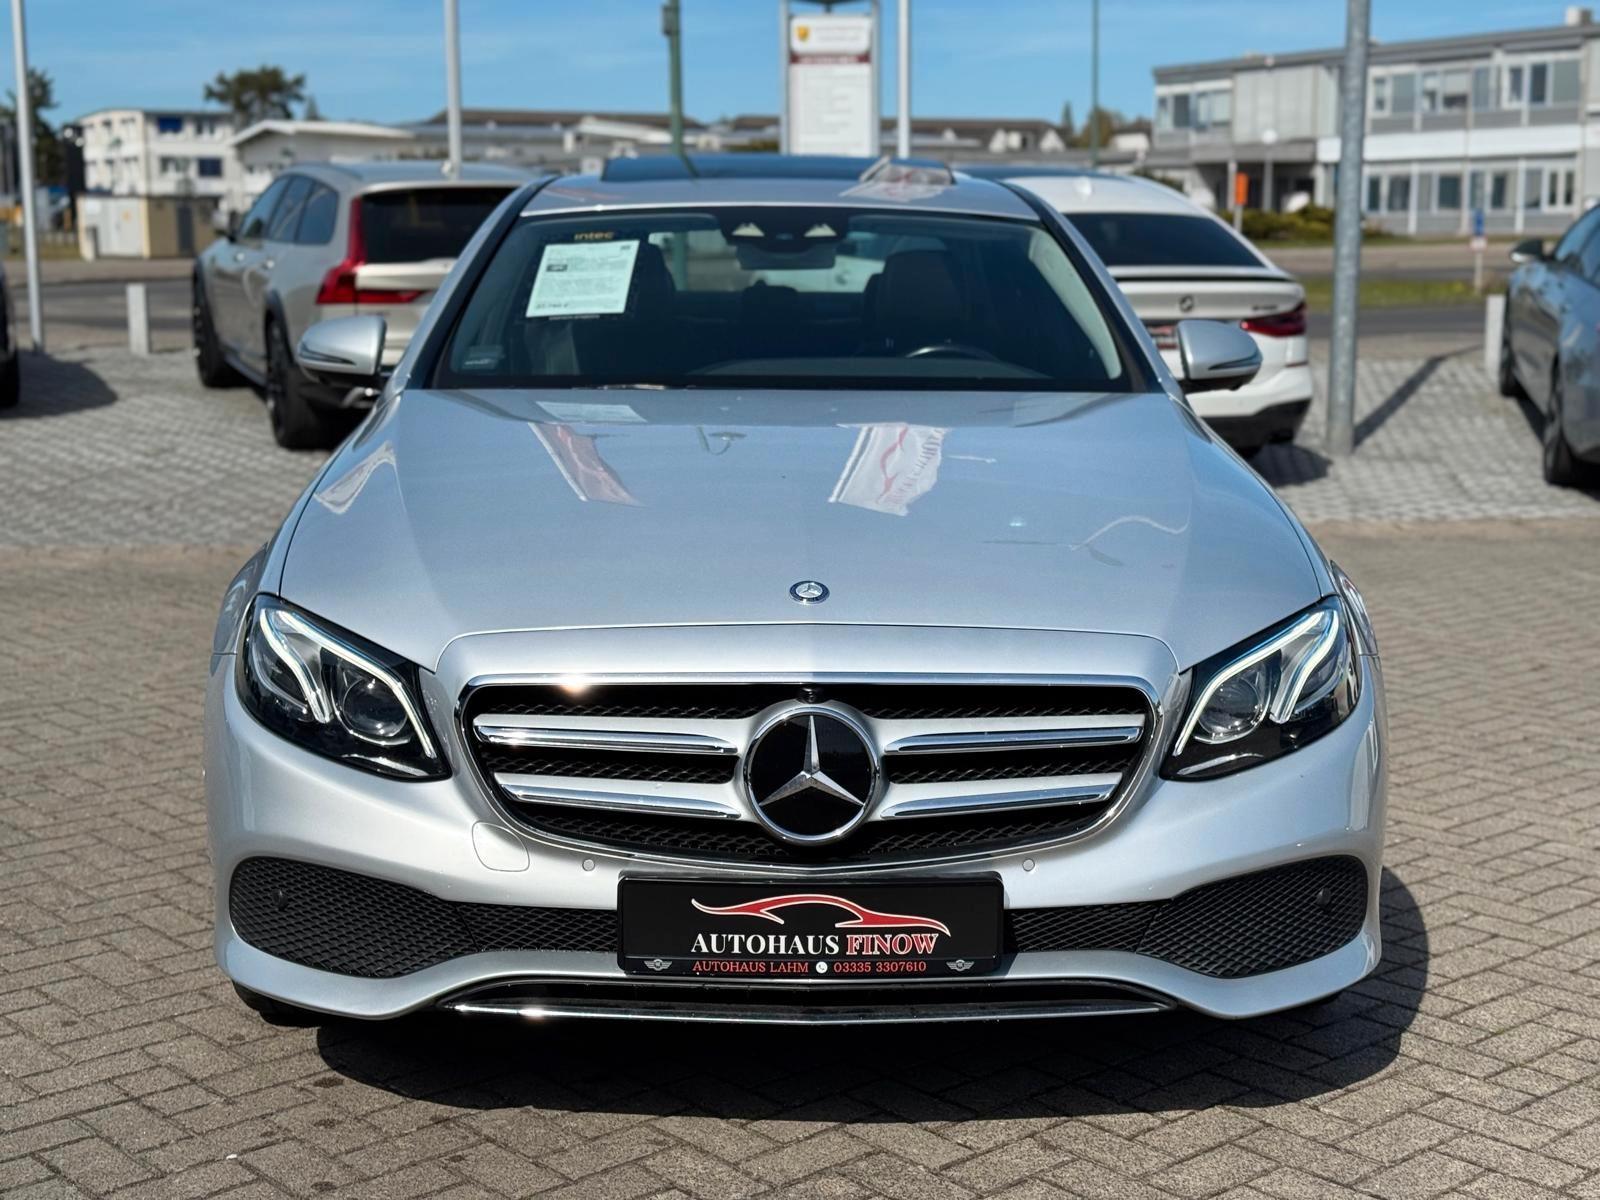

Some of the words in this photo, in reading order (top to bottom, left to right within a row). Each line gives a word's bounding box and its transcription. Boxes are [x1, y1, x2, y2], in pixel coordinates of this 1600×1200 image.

[690, 933, 839, 955] AUTOHAUS
[846, 933, 939, 955] FINOW
[692, 960, 766, 973] AUTOHAUS
[769, 961, 809, 973] LAHM
[833, 961, 871, 973] 03335
[875, 961, 927, 973] 3307610
